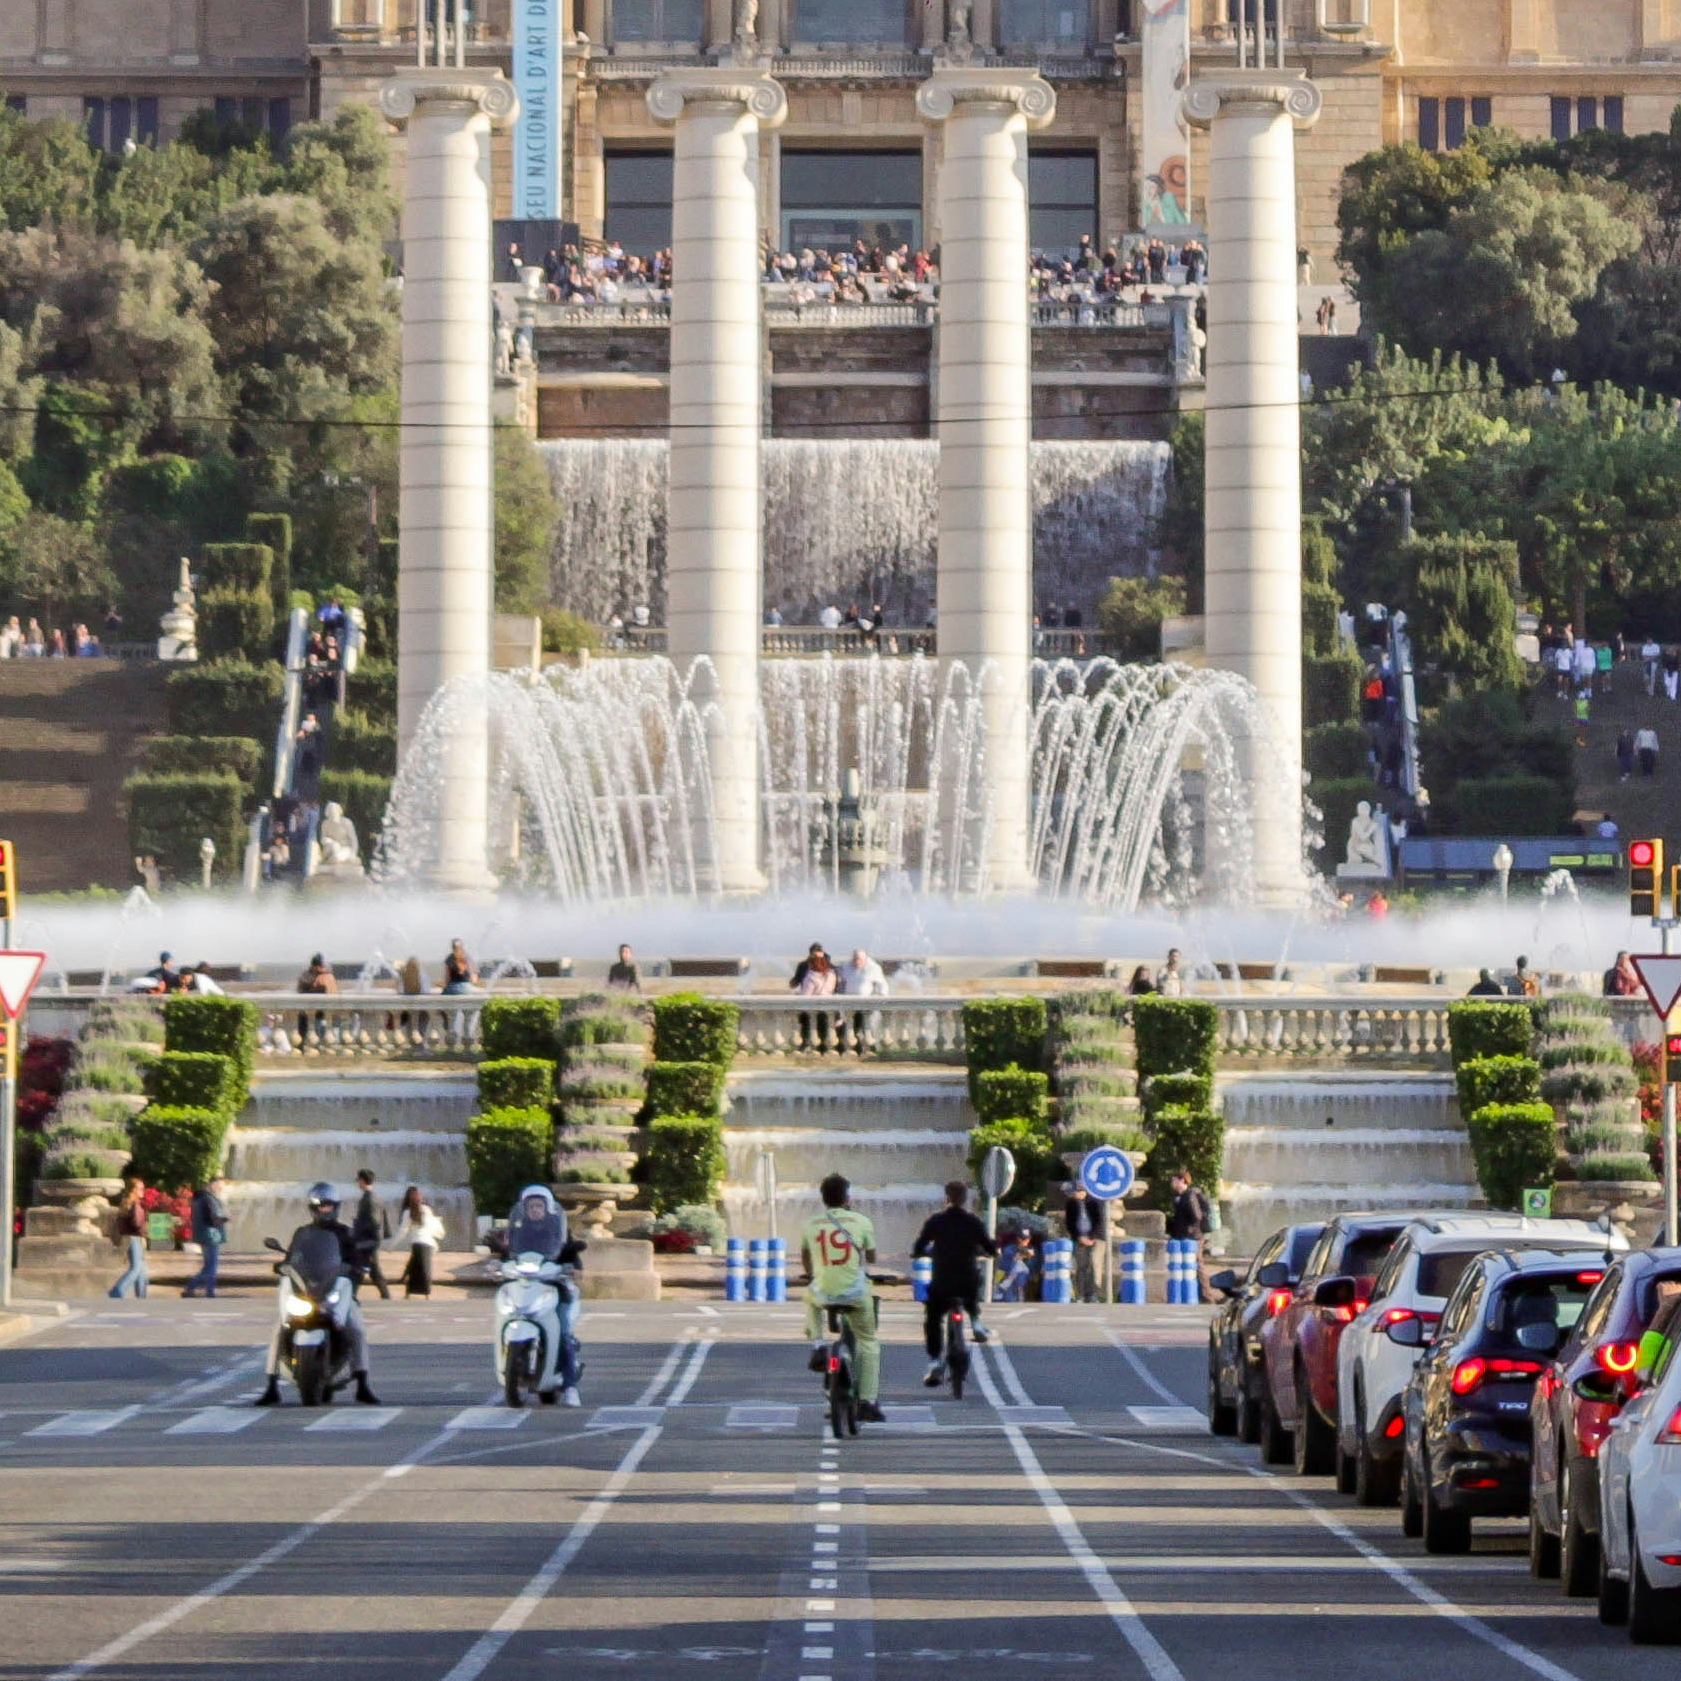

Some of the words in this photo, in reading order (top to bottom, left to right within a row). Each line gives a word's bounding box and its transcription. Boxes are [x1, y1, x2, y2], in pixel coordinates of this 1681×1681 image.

[527, 26, 547, 78] D'ART
[527, 86, 547, 177] NACIONAL
[815, 1229, 852, 1266] 19
